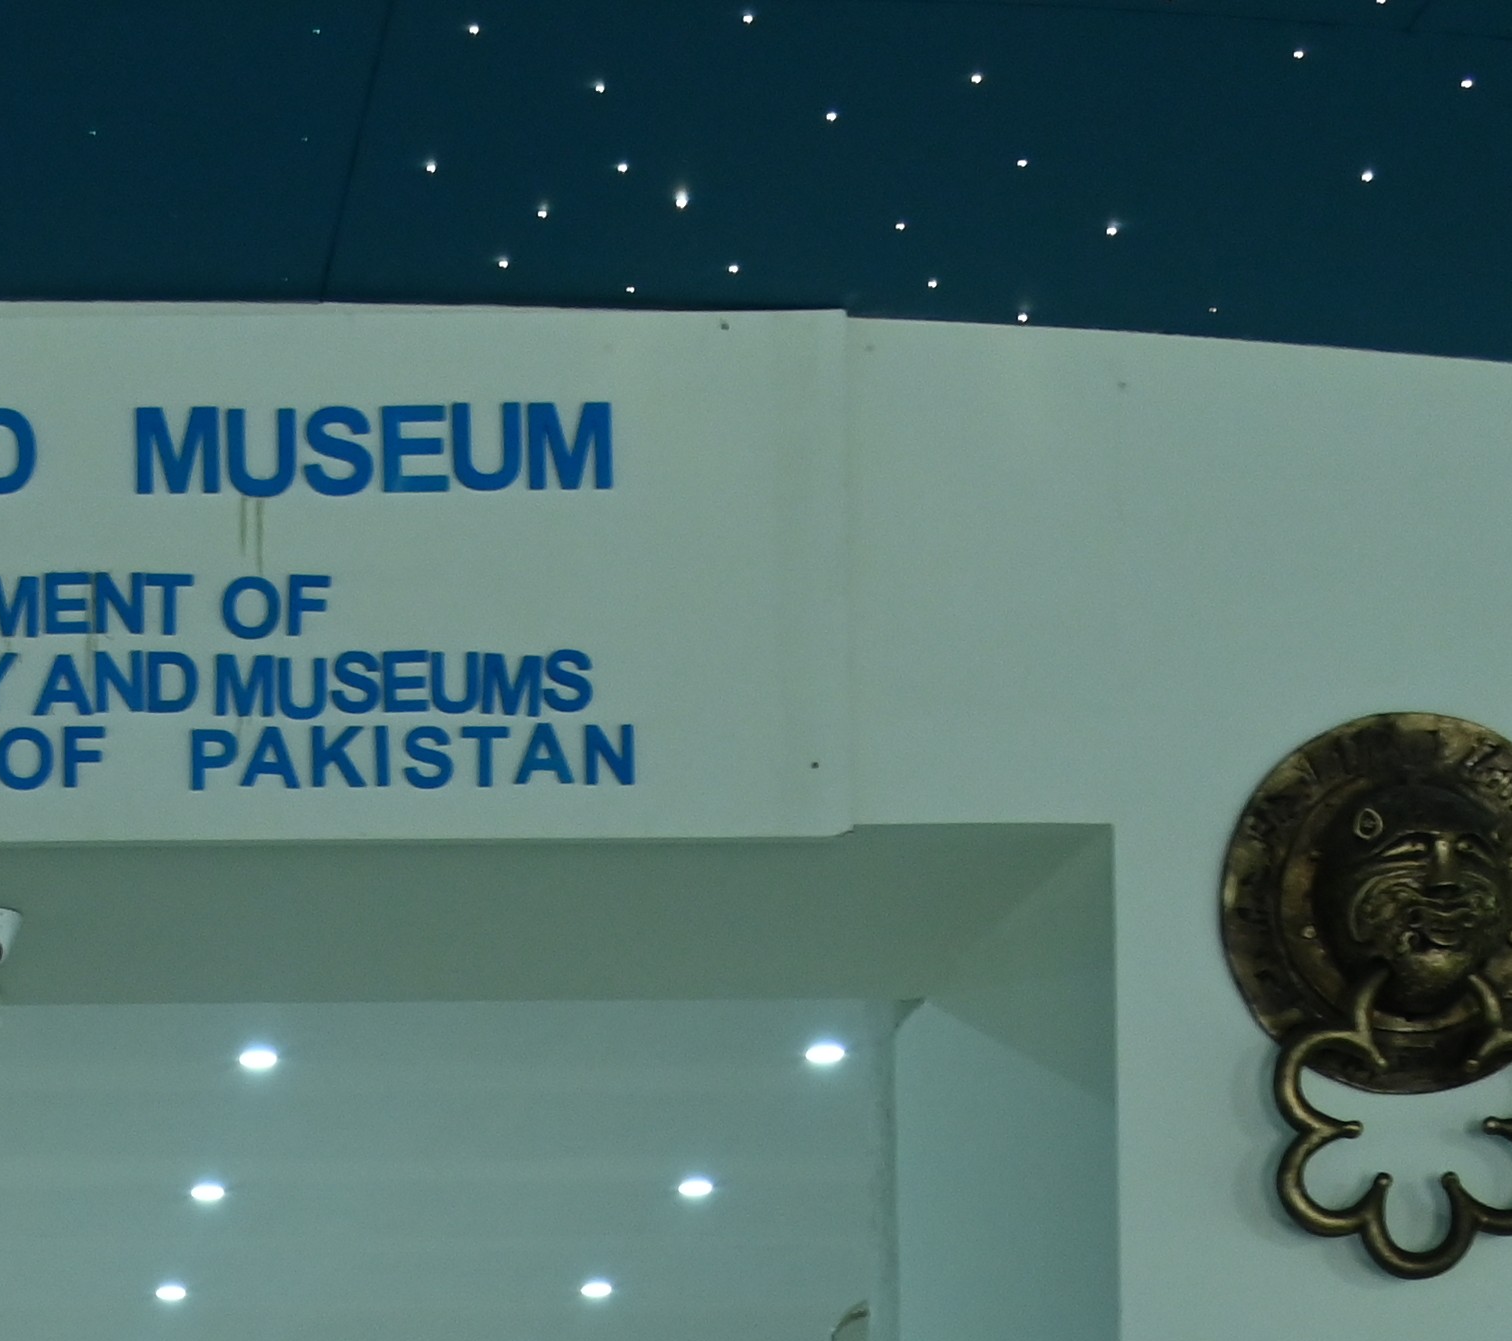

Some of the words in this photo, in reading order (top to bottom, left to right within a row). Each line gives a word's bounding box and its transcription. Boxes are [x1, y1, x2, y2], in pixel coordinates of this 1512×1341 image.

[132, 402, 614, 497] MUSEUM
[219, 573, 331, 637] OF
[32, 655, 198, 716] AND
[212, 650, 594, 718] MUSEUMS
[186, 722, 636, 788] PAKISTAN
